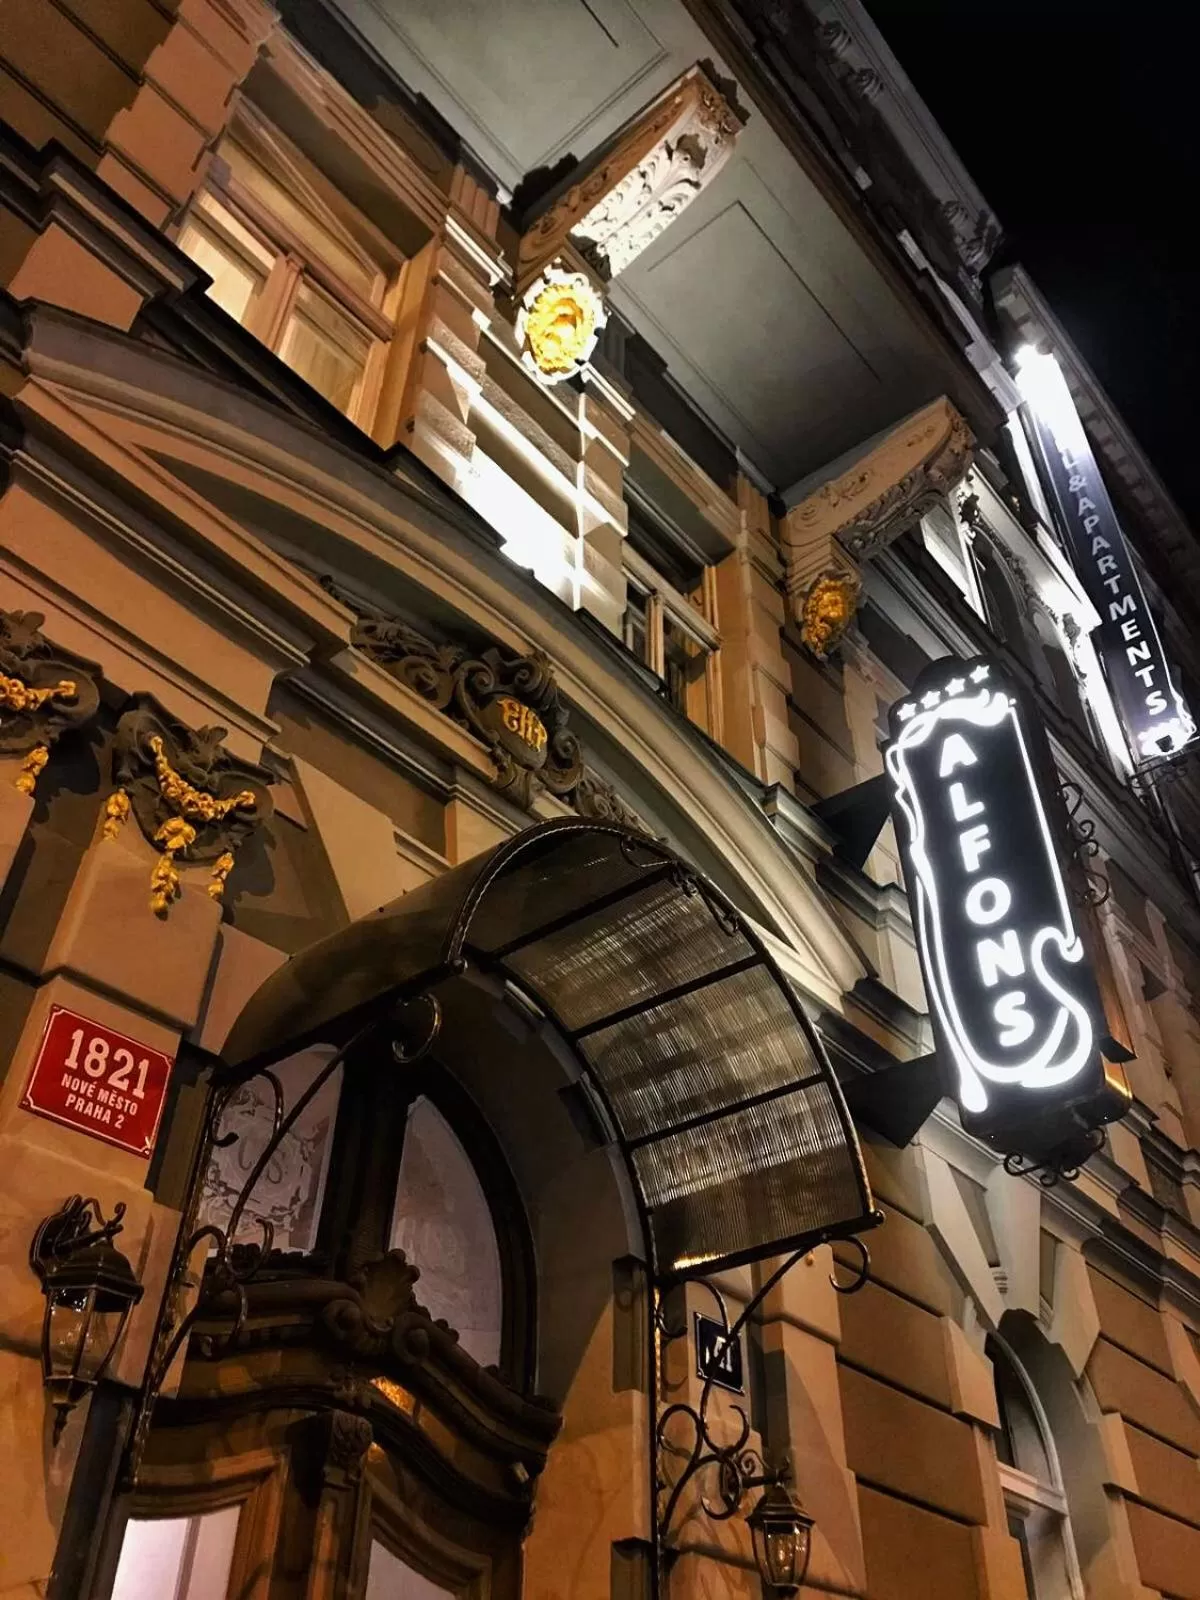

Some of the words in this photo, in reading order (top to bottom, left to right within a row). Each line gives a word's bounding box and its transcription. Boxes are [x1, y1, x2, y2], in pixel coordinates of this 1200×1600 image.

[1076, 496, 1168, 716] APARTMENTS
[939, 733, 1035, 1047] ALFONS
[61, 1073, 97, 1097] NOVÉ
[97, 1089, 138, 1116] MĚSTO
[64, 1029, 149, 1099] 1821
[64, 1094, 111, 1124] PRAHA
[115, 1114, 125, 1129] 2
